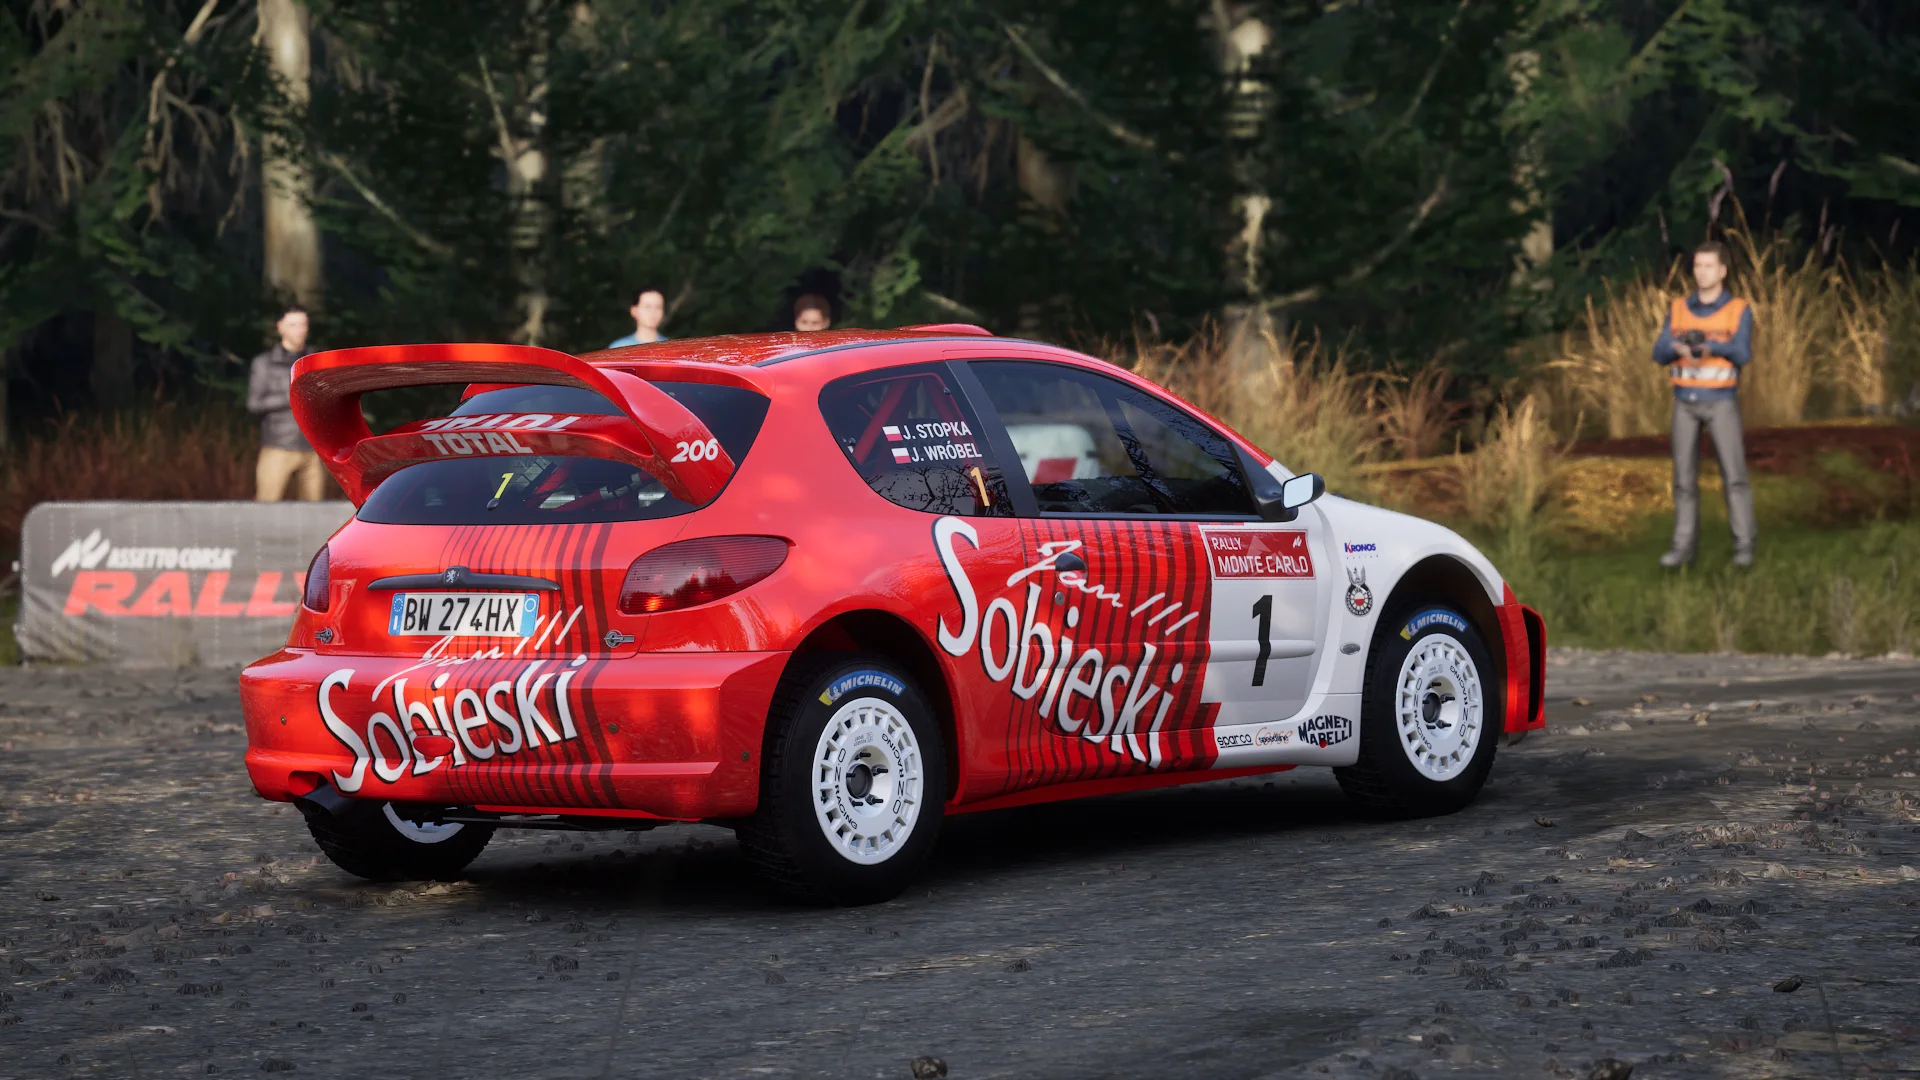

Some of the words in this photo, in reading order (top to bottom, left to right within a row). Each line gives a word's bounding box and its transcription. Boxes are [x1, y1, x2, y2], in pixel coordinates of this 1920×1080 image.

[902, 425, 917, 440] J.
[916, 421, 972, 439] STOPKA
[421, 432, 534, 455] TOTAL
[671, 438, 718, 463] 206
[911, 446, 925, 462] J.
[924, 441, 982, 461] WRÓBEL
[495, 473, 515, 499] 1
[970, 466, 990, 507] 1
[1211, 537, 1242, 551] RALLY
[1344, 540, 1377, 553] KRONOS
[1217, 555, 1264, 573] MONTE
[1267, 555, 1309, 573] CARLO
[404, 598, 432, 631] BW
[438, 598, 519, 632] 274HX
[1417, 613, 1466, 632] MICHELIN
[931, 516, 1184, 770] Sobieski
[1251, 595, 1273, 686] 1
[840, 675, 903, 695] MICHELIN
[318, 654, 588, 793] Sobieski
[1217, 734, 1253, 747] sparco
